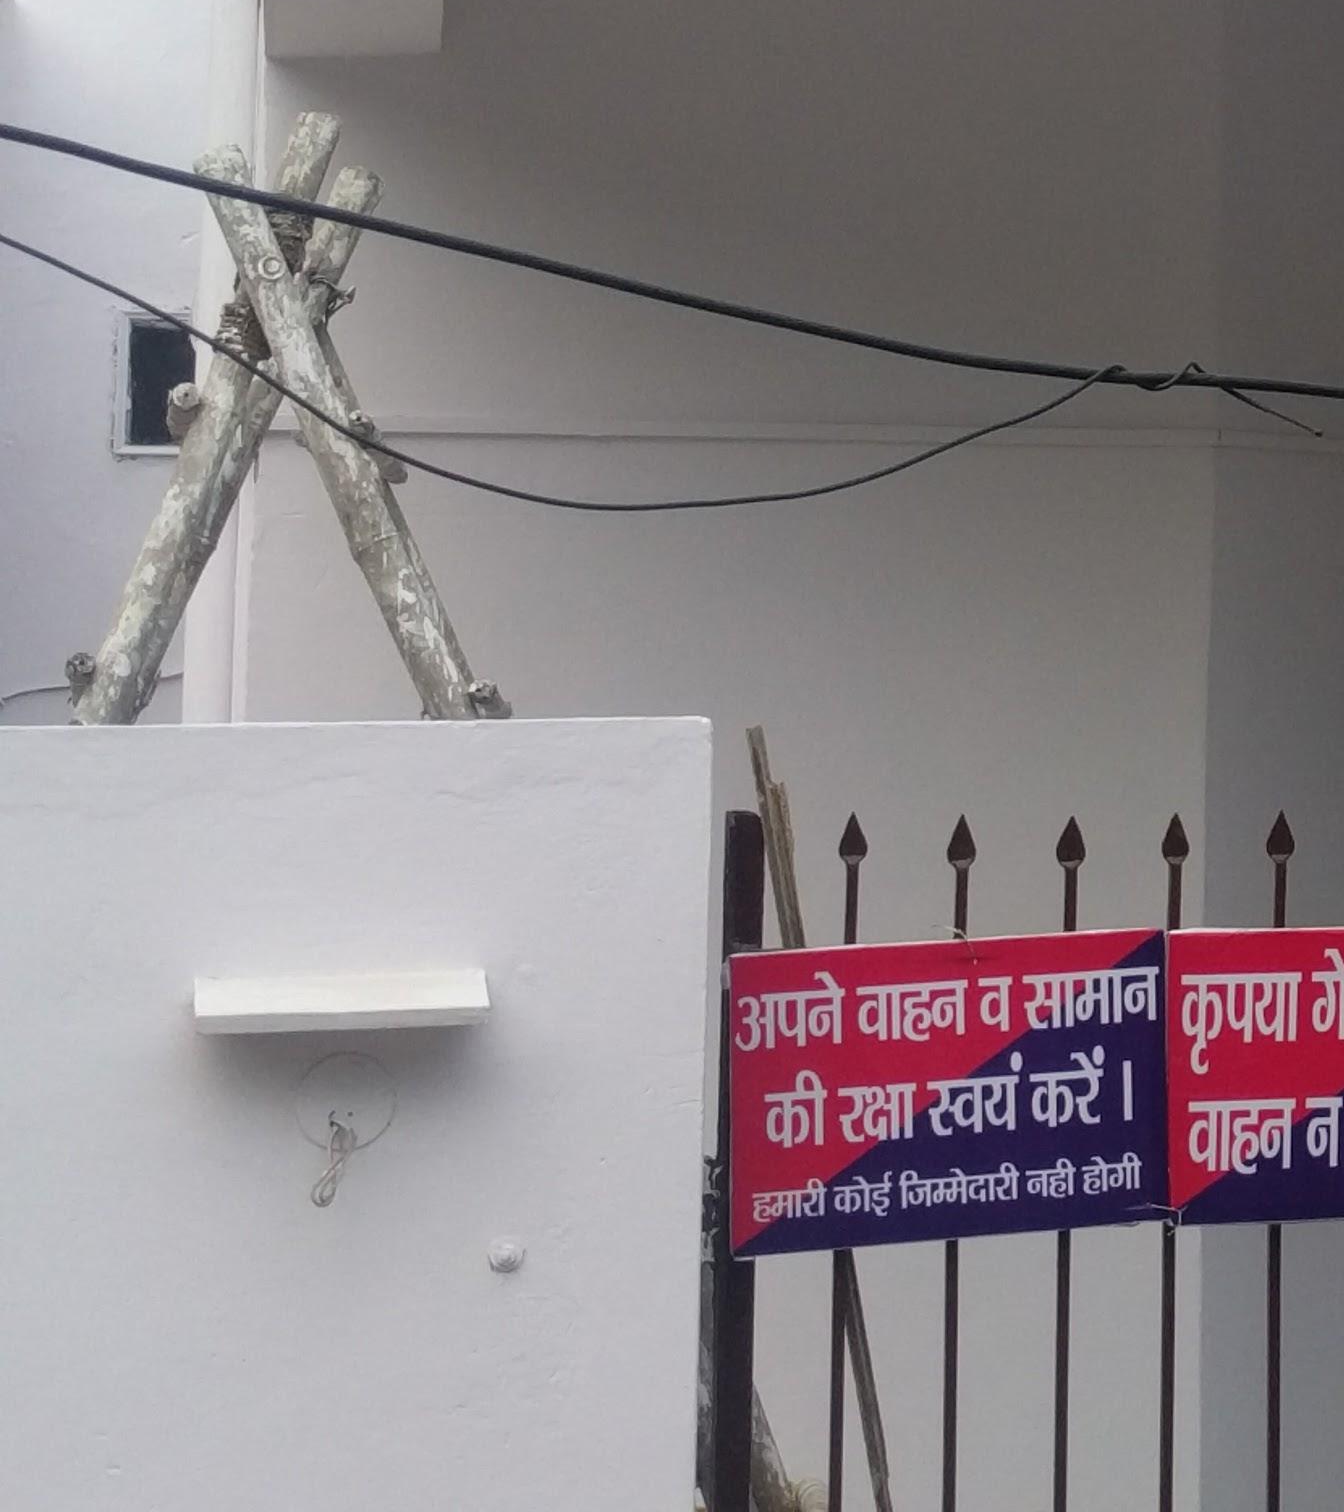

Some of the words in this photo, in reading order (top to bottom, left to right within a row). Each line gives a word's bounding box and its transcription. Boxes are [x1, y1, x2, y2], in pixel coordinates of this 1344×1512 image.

[735, 971, 845, 1051] अपने
[856, 979, 968, 1040] वाहन
[979, 976, 1012, 1032] व
[1022, 966, 1159, 1029] सामान
[1180, 971, 1301, 1074] कृपया
[764, 1069, 827, 1148] की
[838, 1082, 917, 1142] रक्षा
[927, 1052, 1020, 1136] स्वयं
[1029, 1045, 1105, 1127] करें
[1188, 1098, 1296, 1175] वाहन
[1305, 1096, 1343, 1168] न
[752, 1177, 827, 1222] हमारी
[834, 1171, 894, 1216] कोई
[900, 1162, 1019, 1209] जिम्मेदारी
[1026, 1159, 1075, 1200] नही
[1082, 1152, 1142, 1193] होगी
